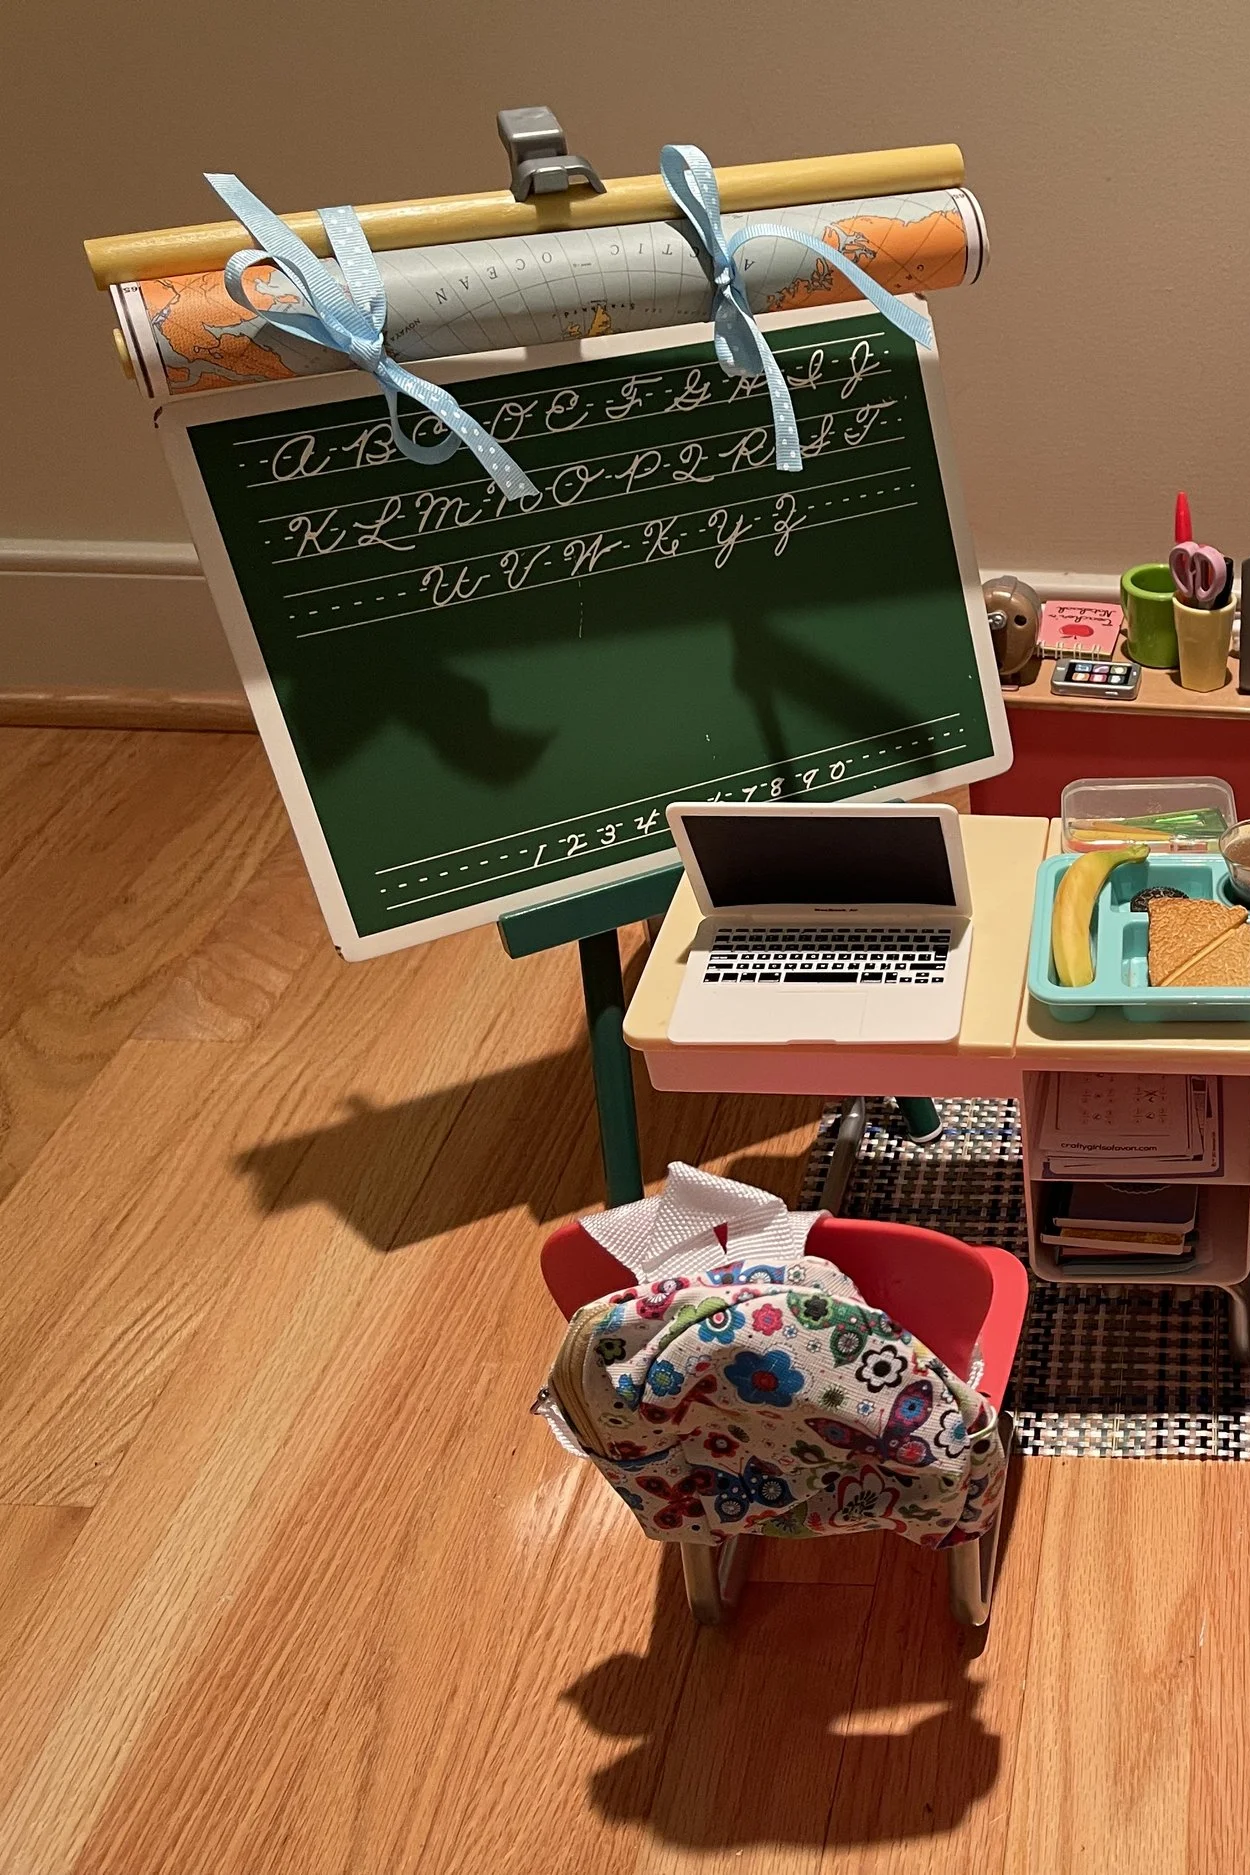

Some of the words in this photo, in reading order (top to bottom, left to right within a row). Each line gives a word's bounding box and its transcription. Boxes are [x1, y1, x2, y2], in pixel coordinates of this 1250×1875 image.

[434, 251, 553, 305] OCEAN
[390, 318, 421, 341] NOVAYA
[272, 435, 330, 481] A
[342, 423, 397, 468] B
[545, 389, 589, 432] E
[606, 376, 662, 419] F
[665, 369, 711, 412] G
[841, 340, 880, 399] J
[289, 509, 346, 557] K
[353, 497, 416, 551] L
[415, 492, 482, 533] M
[553, 465, 605, 507] O
[615, 450, 661, 493] P
[719, 428, 775, 472] R
[500, 546, 550, 589] V
[564, 534, 622, 577] W
[708, 509, 752, 568] Y
[773, 493, 807, 556] Z
[1048, 614, 1113, 627] Teacher's
[1056, 606, 1117, 618] Notebook
[533, 844, 547, 867] 1
[567, 833, 587, 857] 2
[600, 824, 617, 845] 3
[634, 808, 661, 835] 4
[742, 785, 757, 803] 7
[770, 777, 785, 797] 8
[802, 769, 820, 791] 9
[1061, 1142, 1158, 1152] craftygirlsofavon.com
